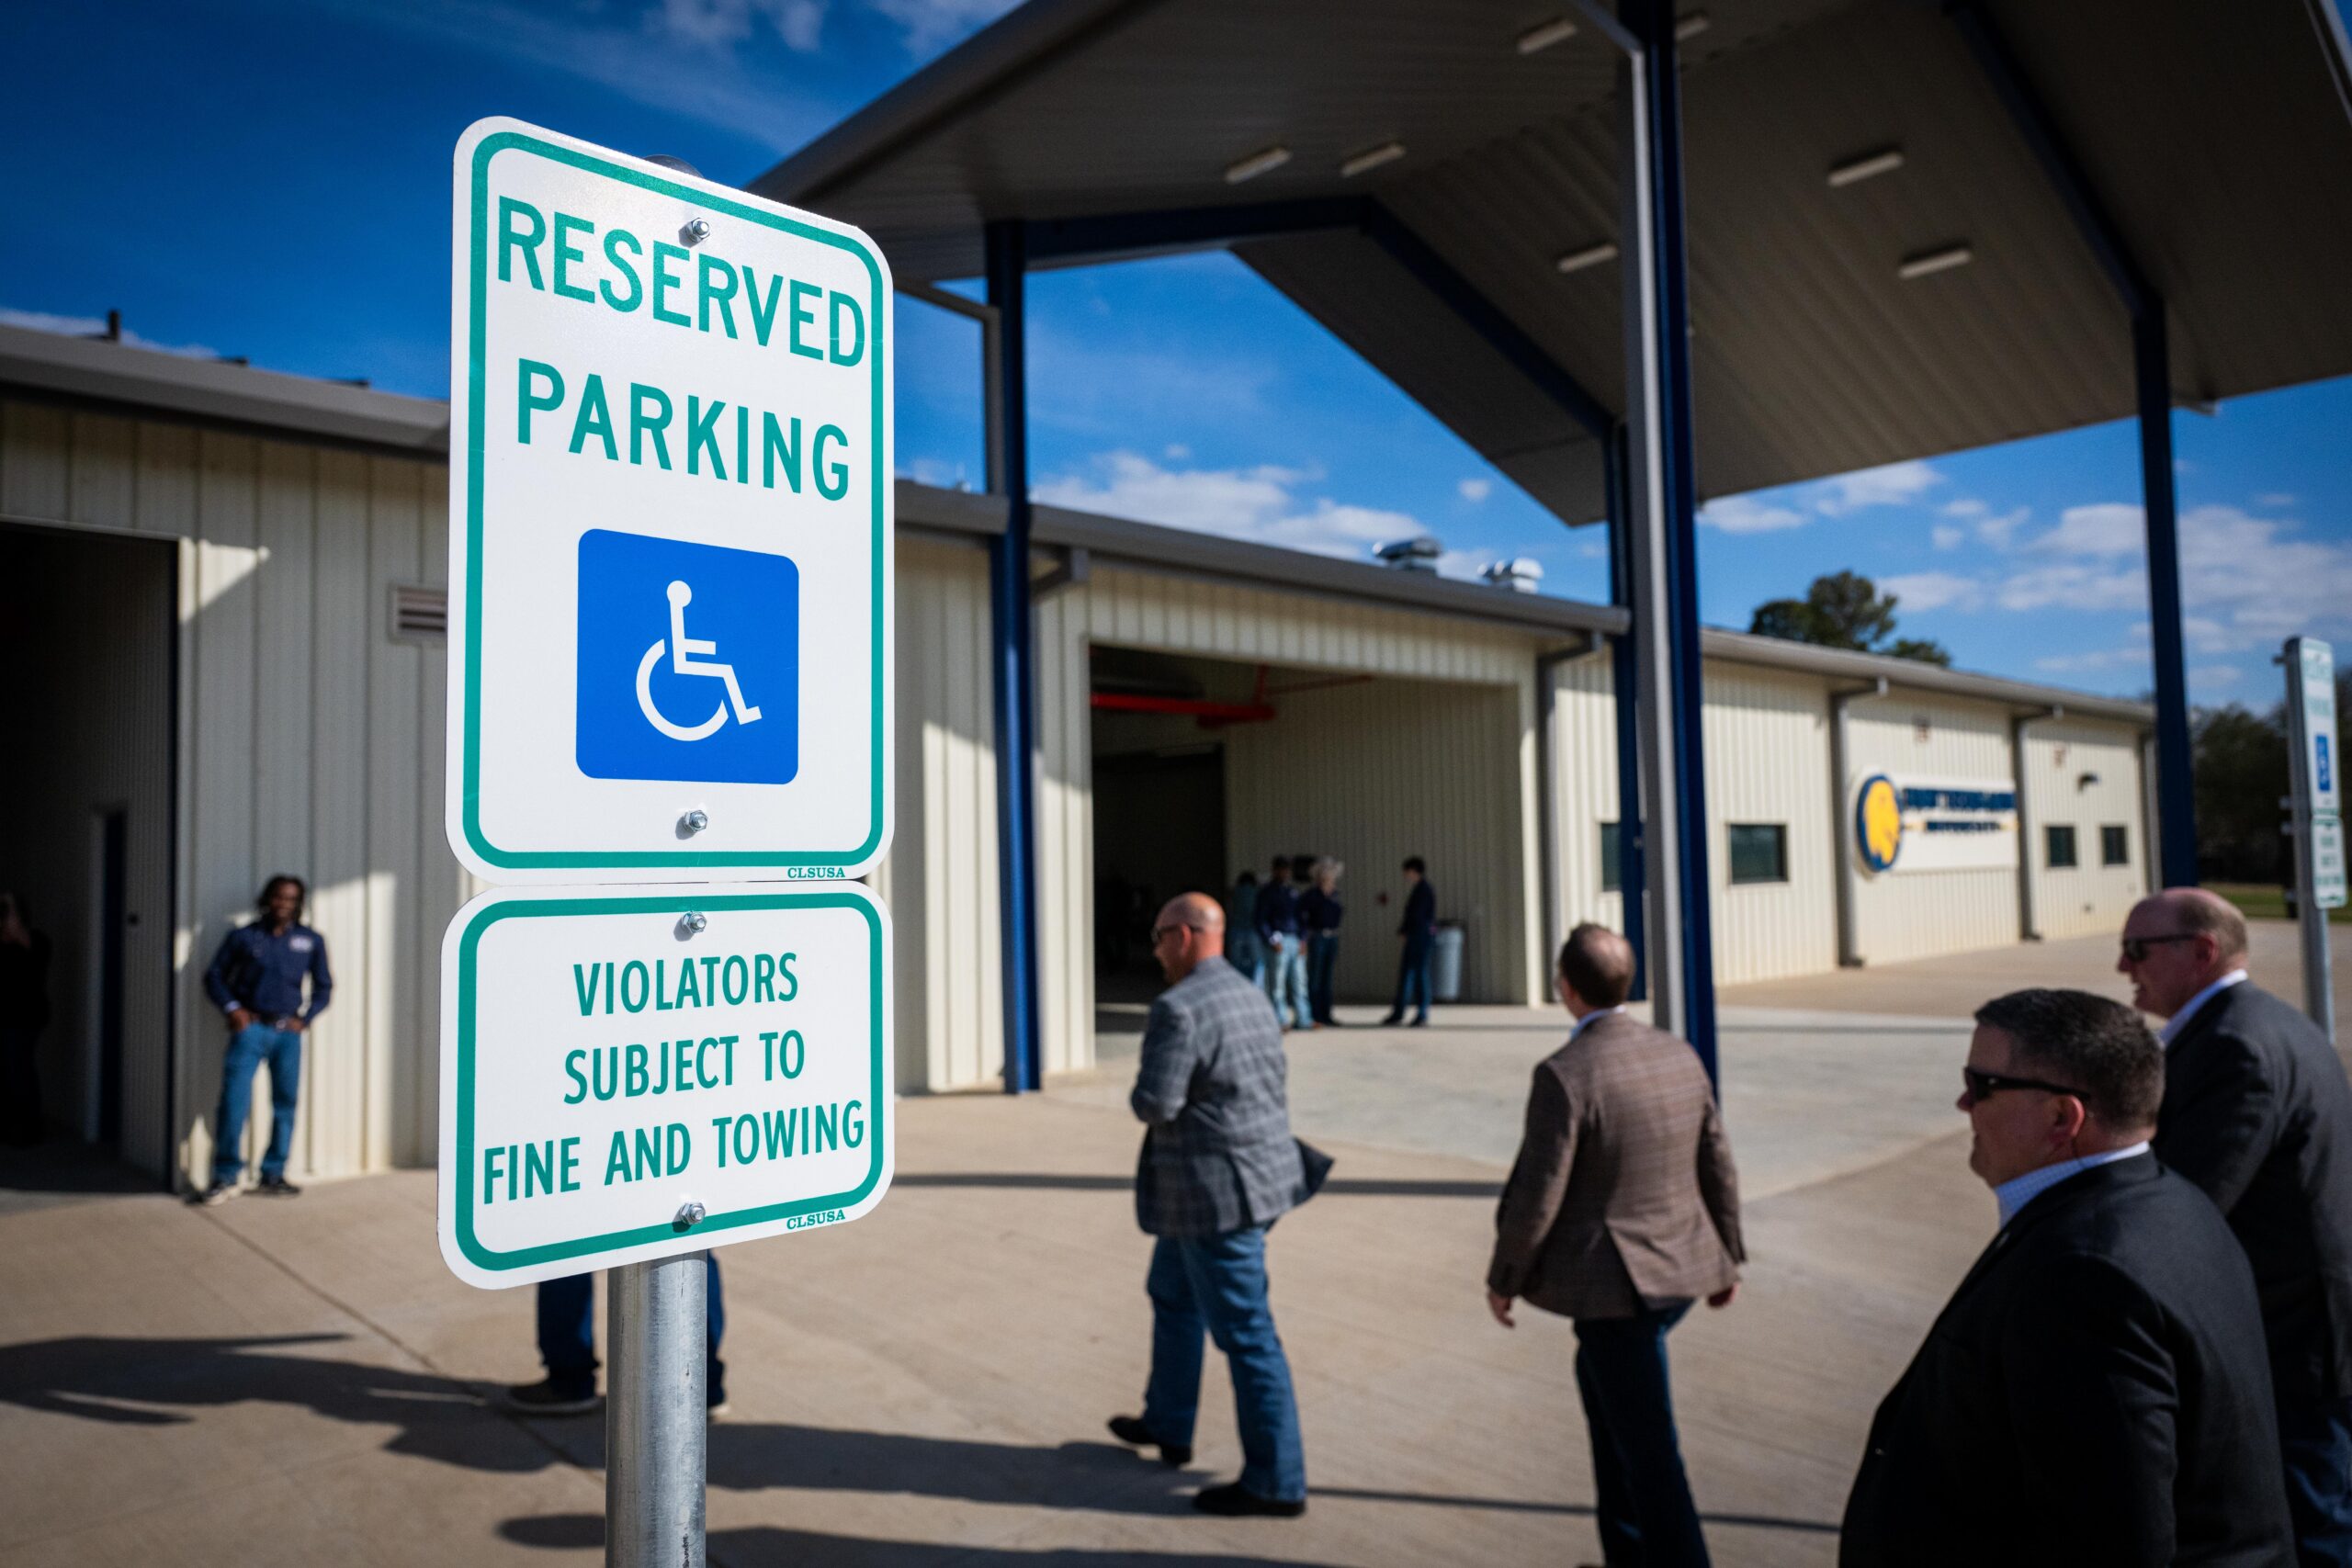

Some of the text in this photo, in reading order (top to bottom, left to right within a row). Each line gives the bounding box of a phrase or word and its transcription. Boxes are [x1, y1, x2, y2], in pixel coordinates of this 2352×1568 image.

[498, 196, 865, 367] RESERVED
[517, 357, 849, 501] PARKING
[786, 867, 845, 878] CLSUSA
[573, 953, 798, 1016] VIOLATORS
[563, 1030, 805, 1104] SUBJECT TO
[483, 1100, 865, 1204] FINE AND TOWING
[786, 1209, 845, 1230] CLSUSA
